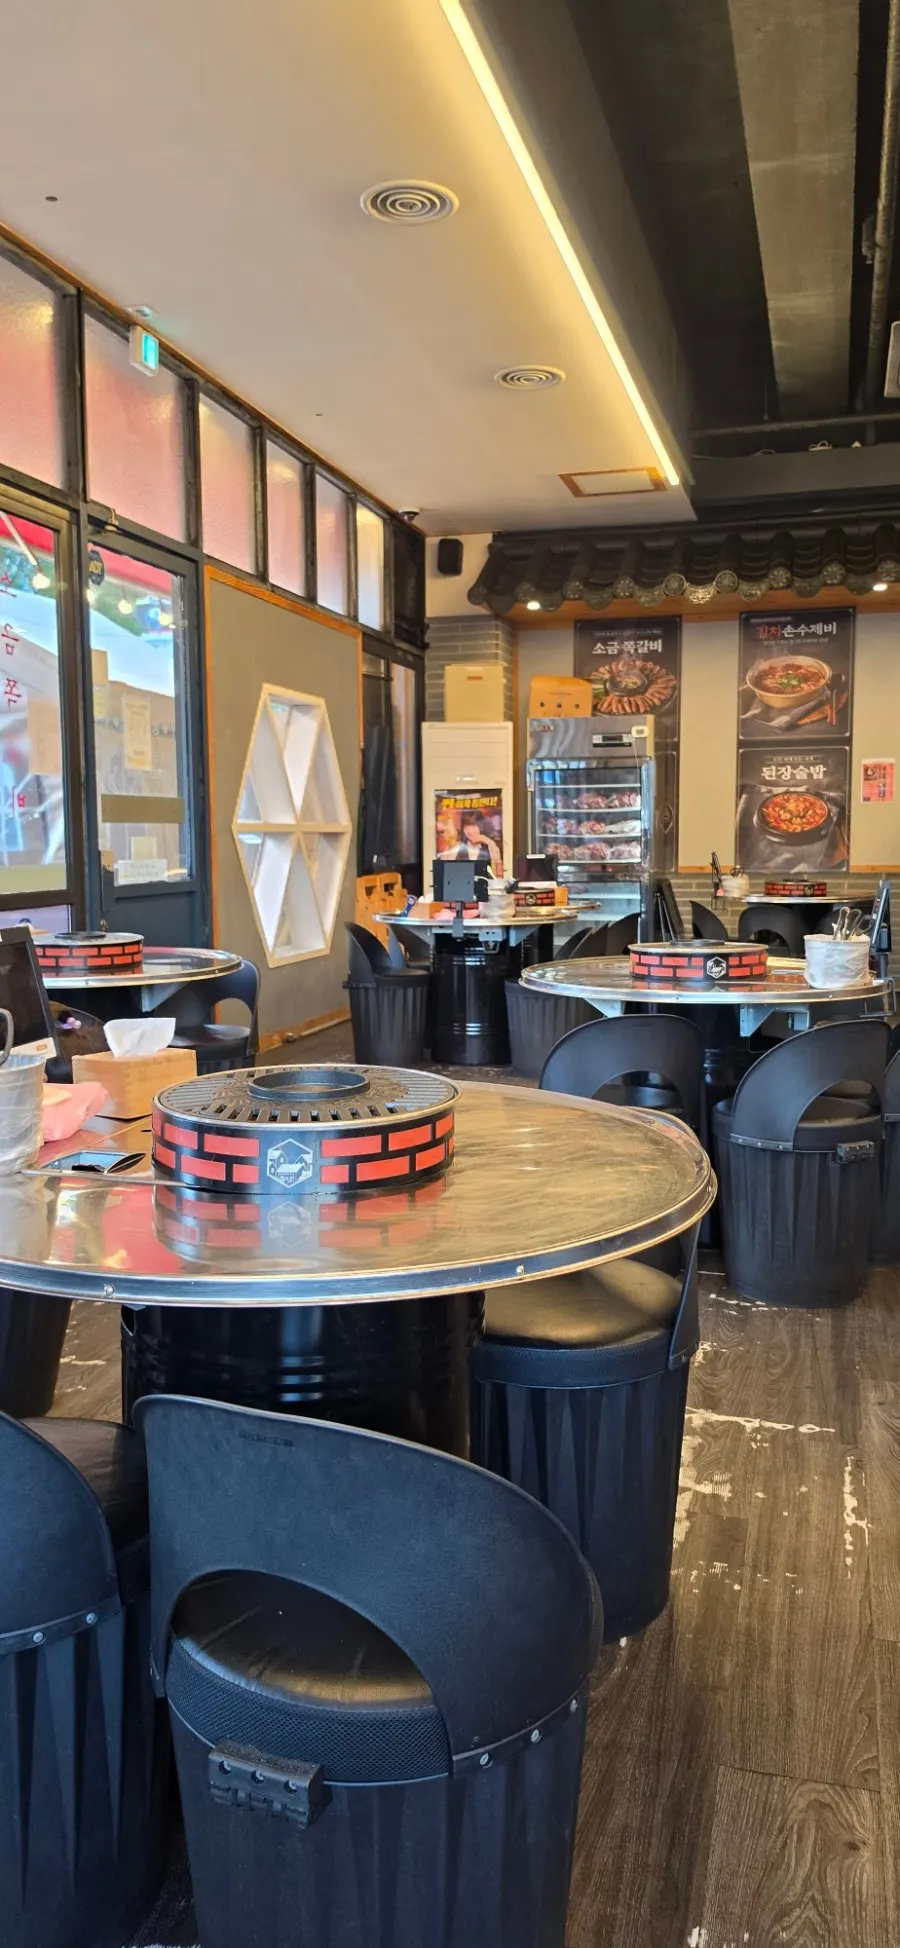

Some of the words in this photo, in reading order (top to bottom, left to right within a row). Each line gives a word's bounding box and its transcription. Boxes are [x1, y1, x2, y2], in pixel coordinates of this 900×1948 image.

[592, 641, 620, 655] 소금
[621, 639, 662, 654] 쪽갈비
[761, 764, 827, 780] 된장술밥
